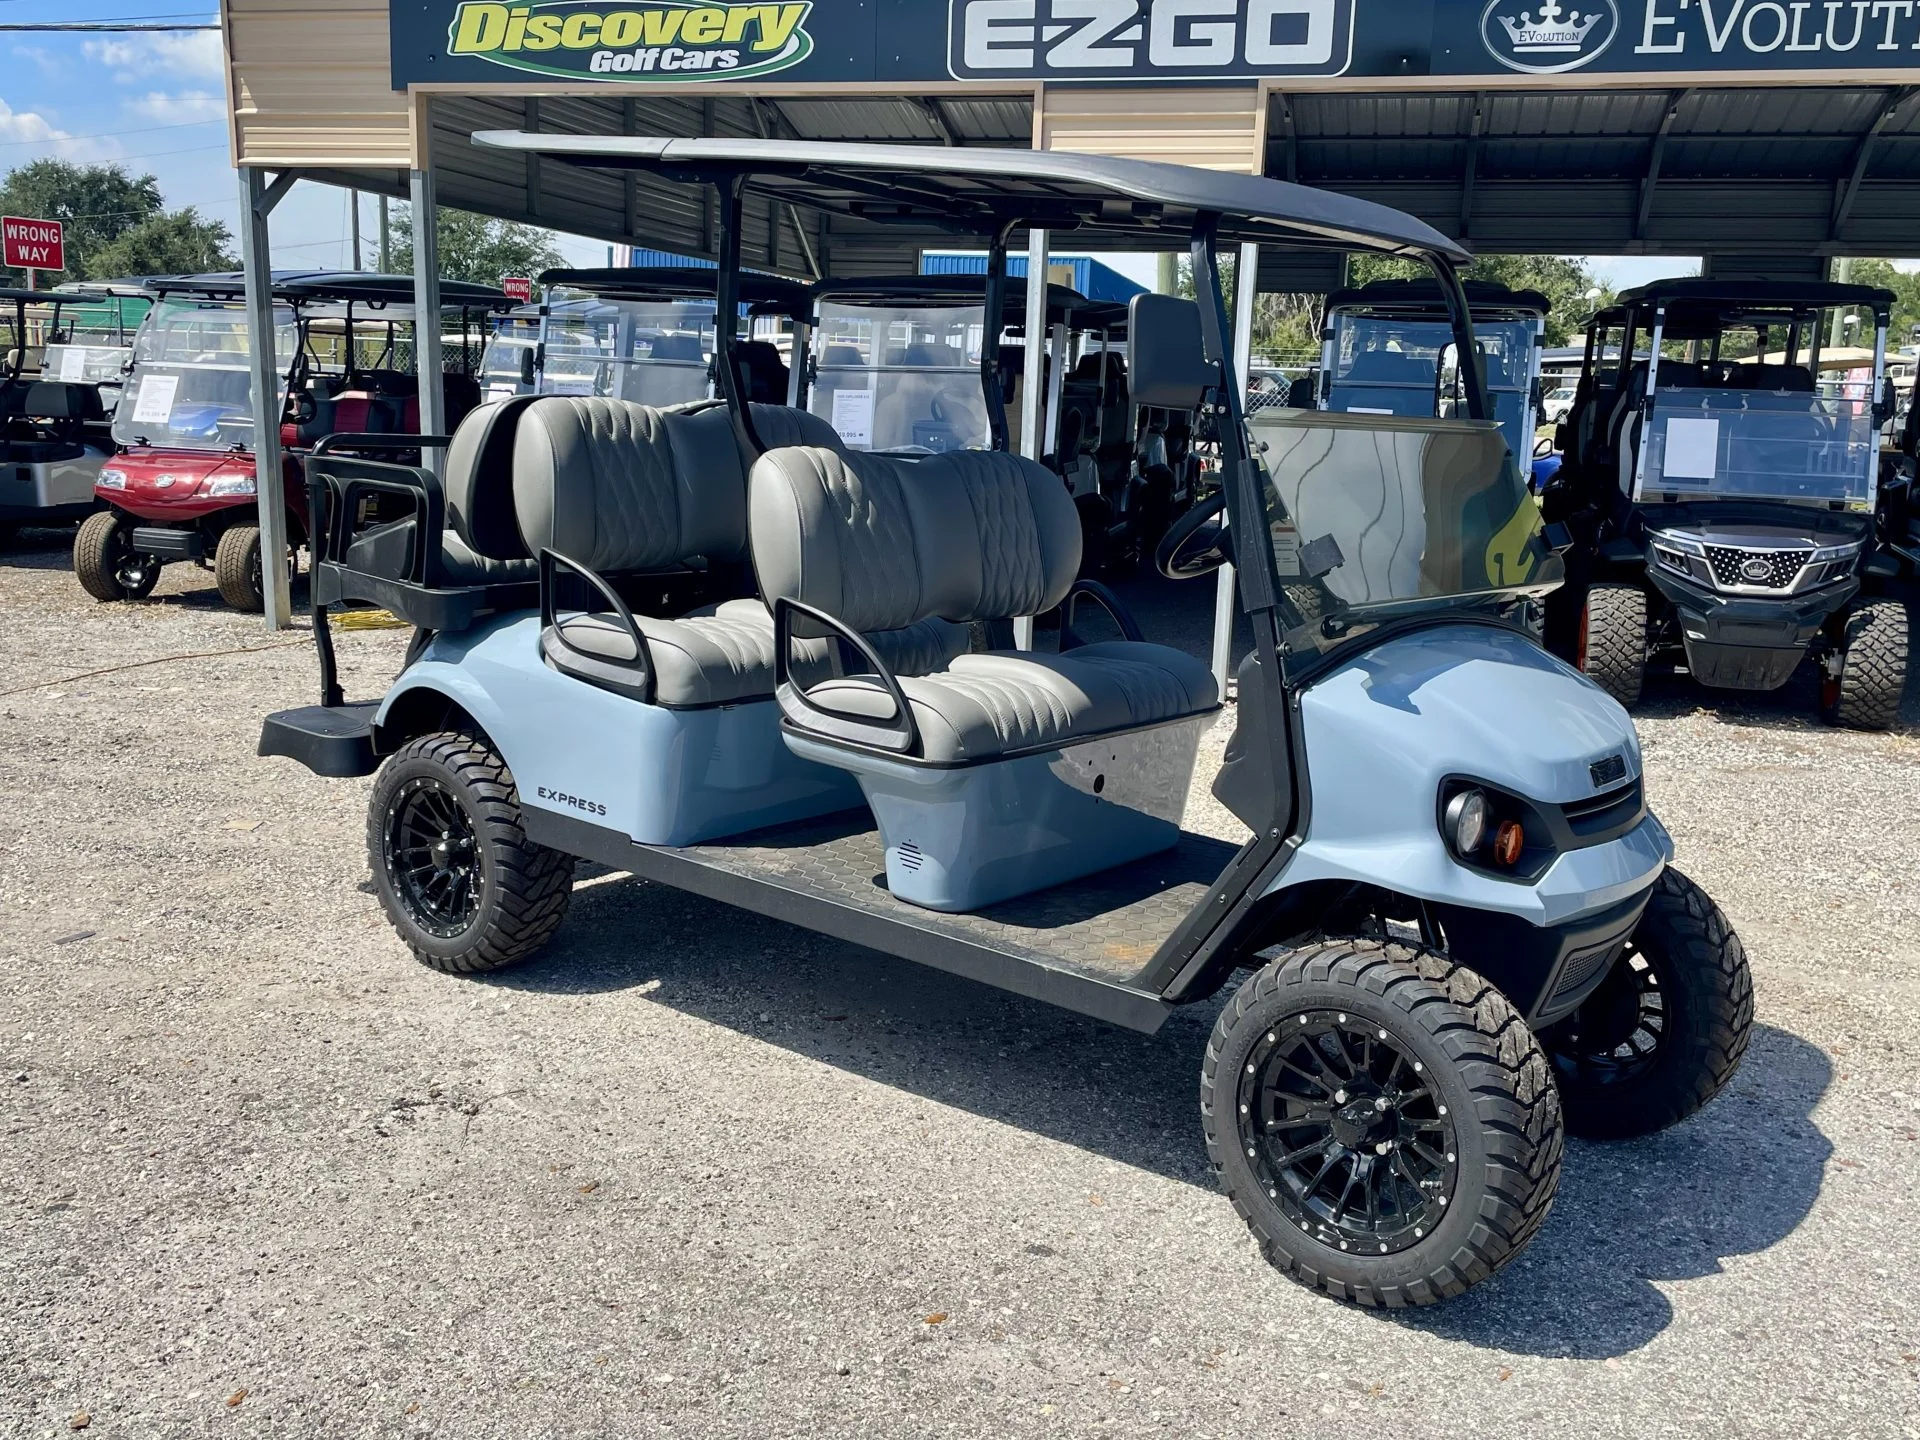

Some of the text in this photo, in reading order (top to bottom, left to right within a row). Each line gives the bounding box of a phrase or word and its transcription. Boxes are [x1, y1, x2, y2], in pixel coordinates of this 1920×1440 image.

[454, 4, 805, 53] Discovery
[963, 0, 1335, 68] EZGO
[1634, 0, 1920, 54] EVOLUT
[589, 48, 739, 73] Golf Cars
[6, 223, 59, 244] WRONG
[17, 245, 49, 262] WAY
[505, 282, 529, 293] WRONG
[537, 786, 607, 816] EXPRESS
